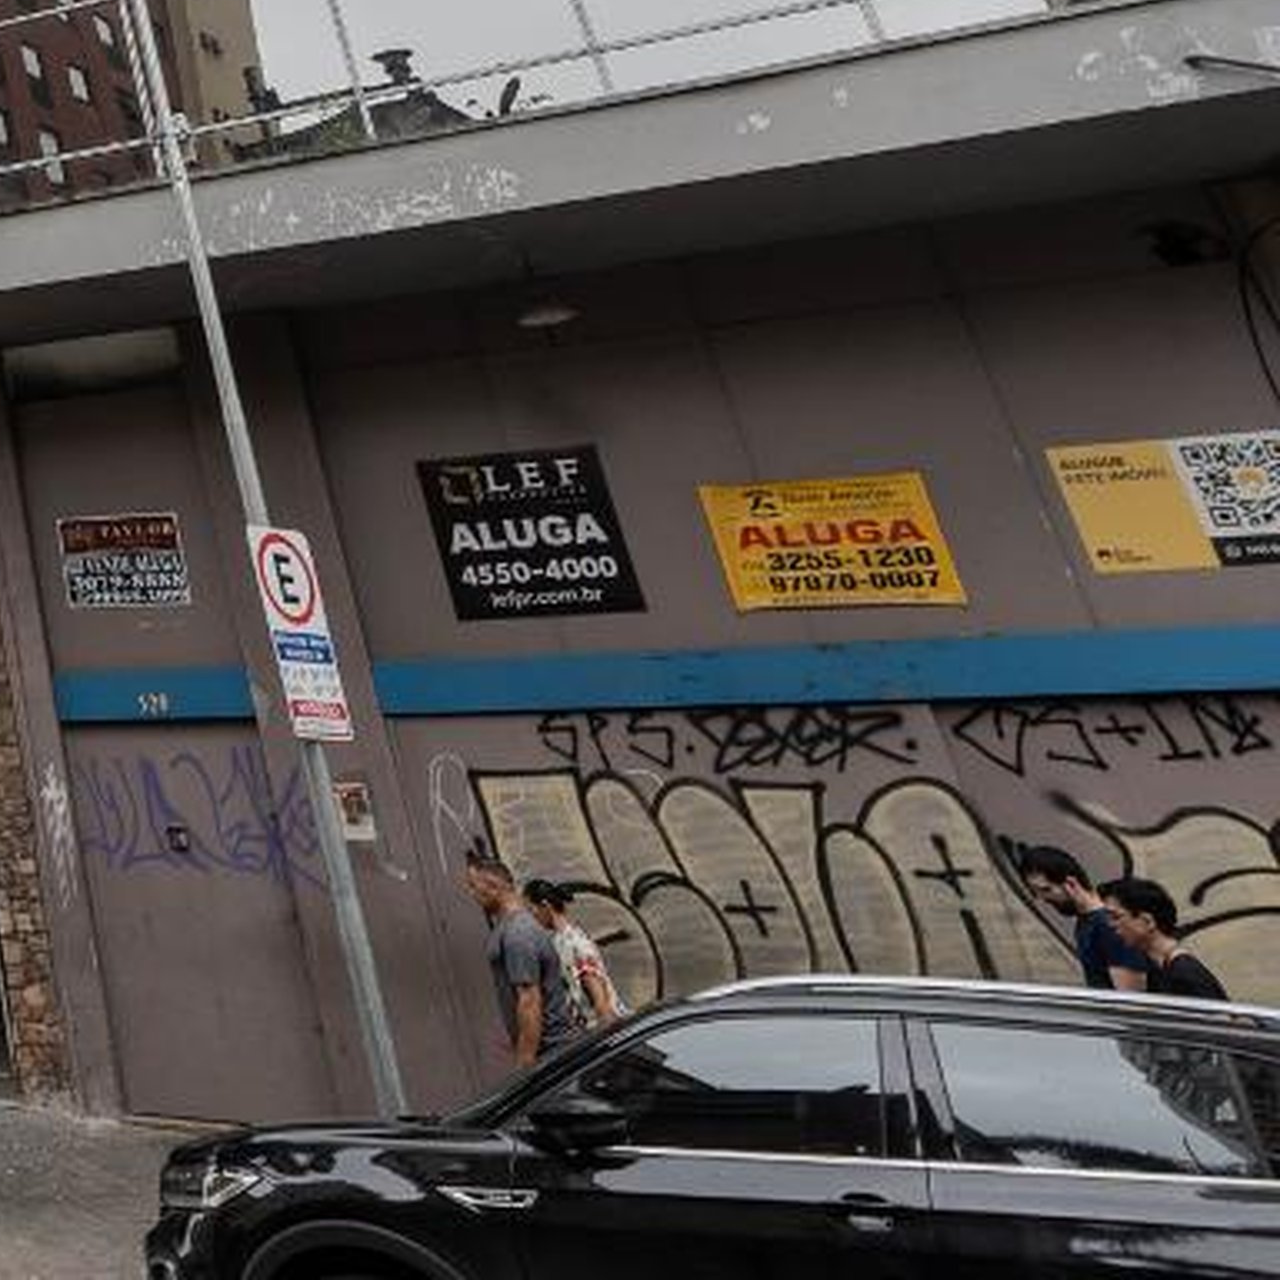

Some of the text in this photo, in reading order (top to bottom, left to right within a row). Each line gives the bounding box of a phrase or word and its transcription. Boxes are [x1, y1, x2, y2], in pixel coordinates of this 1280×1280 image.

[480, 458, 579, 492] LEF
[450, 513, 609, 554] ALUGA
[739, 519, 928, 549] ALUGA
[461, 556, 619, 587] 4550-4000
[767, 546, 936, 572] 3255-1230
[273, 553, 301, 604] E
